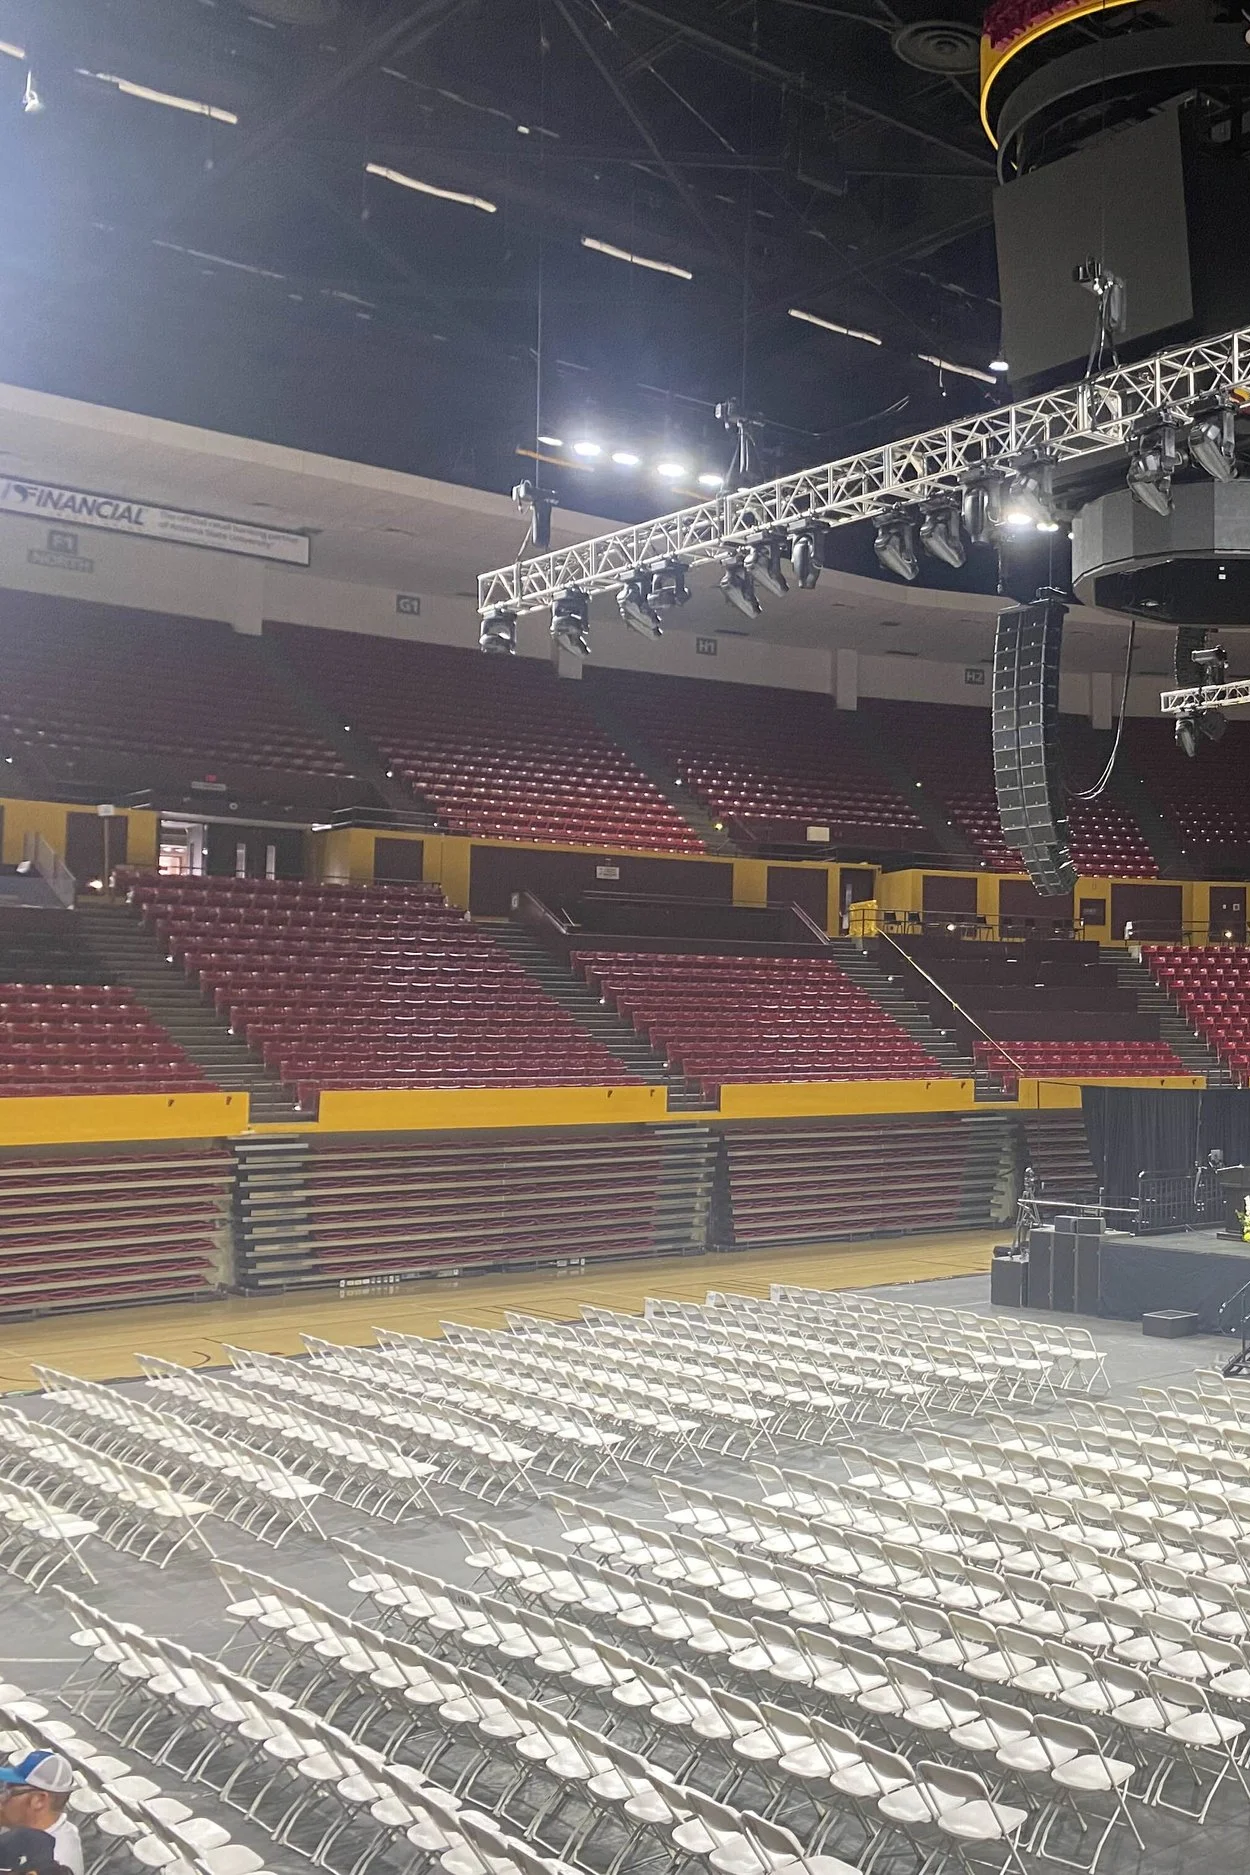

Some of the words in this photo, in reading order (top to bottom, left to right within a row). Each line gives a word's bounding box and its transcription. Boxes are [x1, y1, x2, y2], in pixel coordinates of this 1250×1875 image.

[13, 484, 144, 525] FINANCIAL
[399, 598, 418, 613] G1
[699, 640, 714, 653] H1
[967, 672, 983, 682] H2
